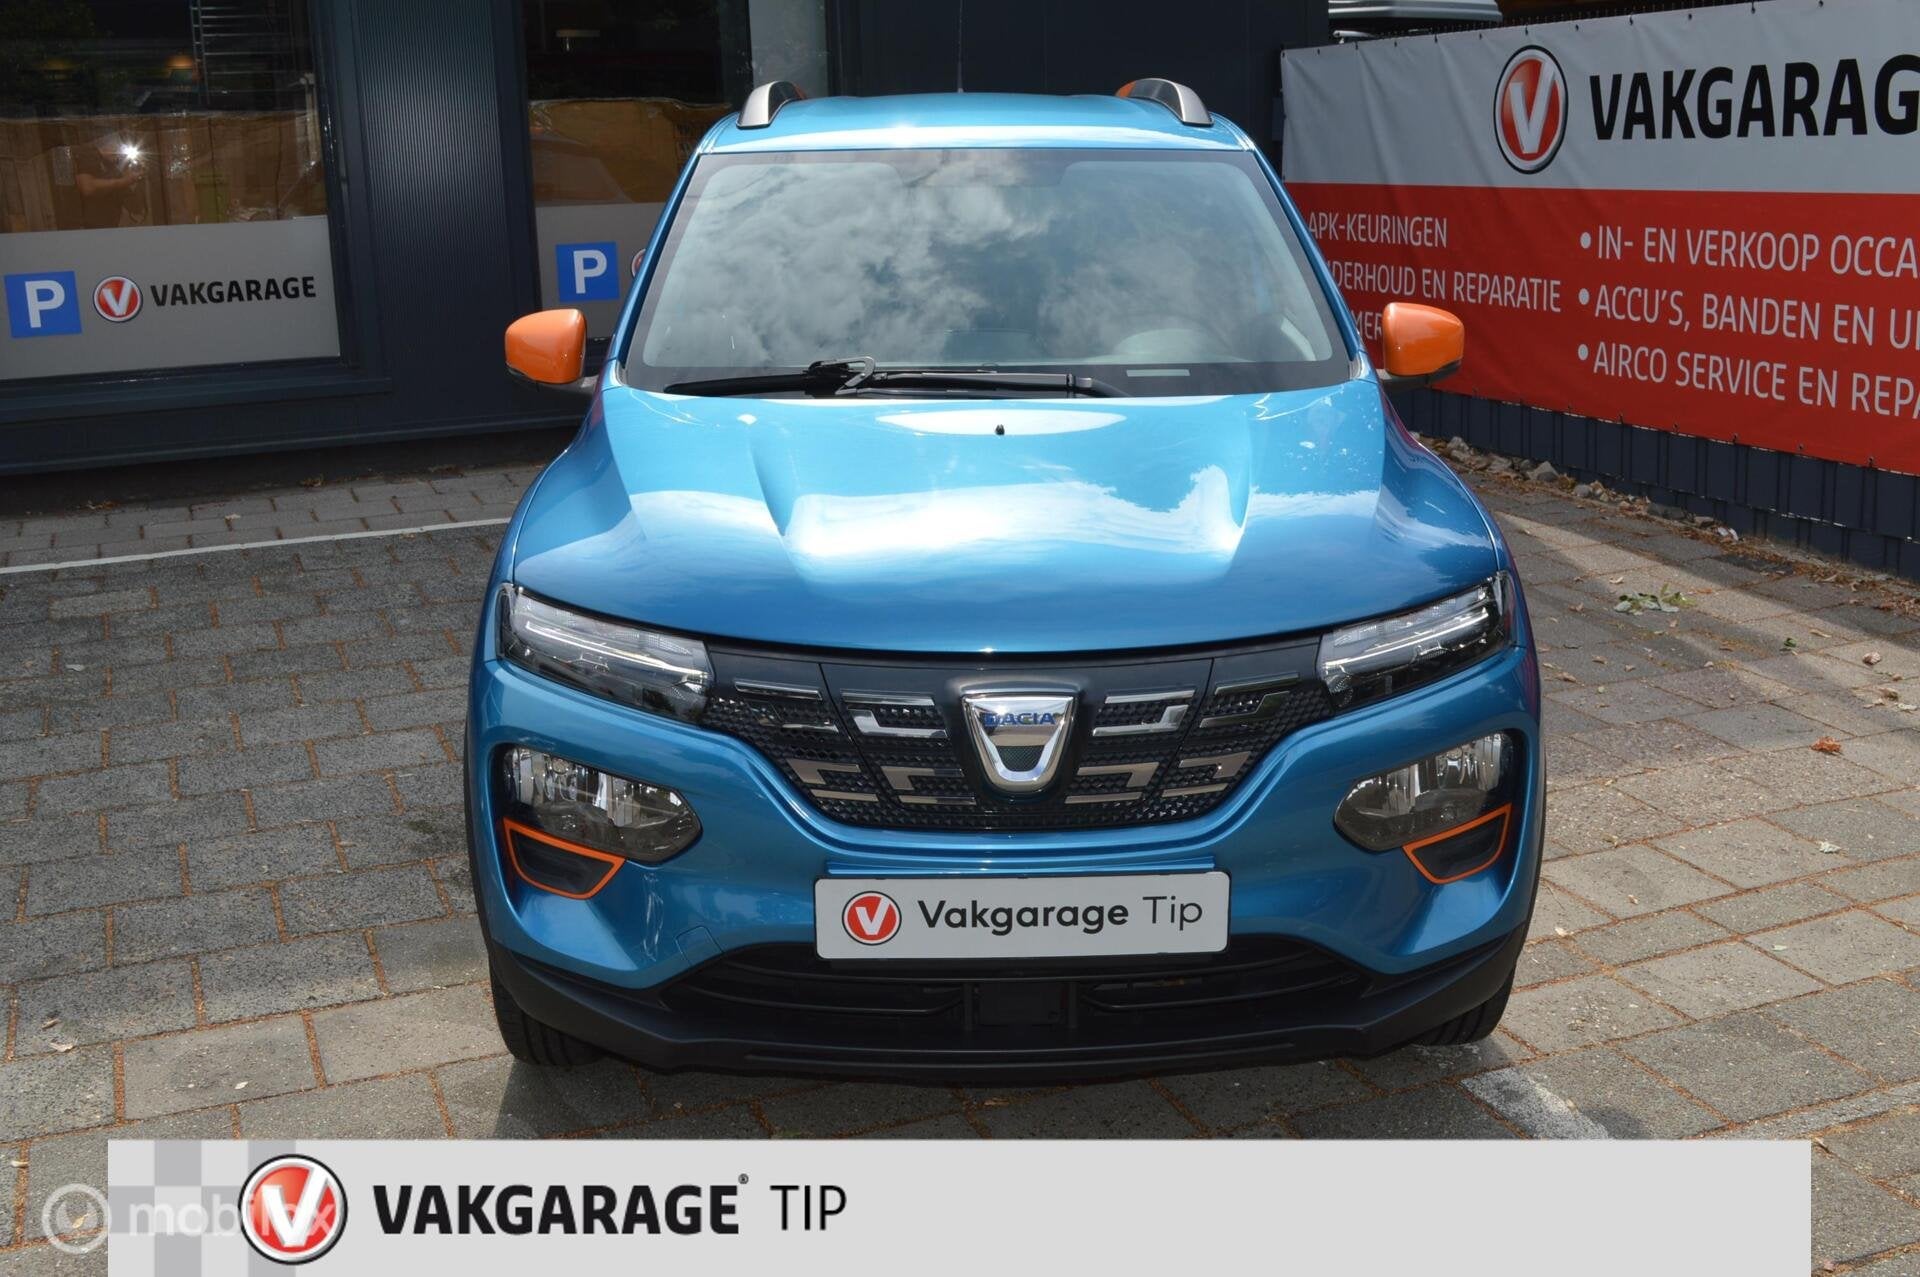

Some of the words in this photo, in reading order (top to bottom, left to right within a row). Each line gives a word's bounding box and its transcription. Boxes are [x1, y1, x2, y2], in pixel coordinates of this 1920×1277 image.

[1589, 53, 1920, 141] VAKGARAG
[1309, 212, 1447, 248] APK-KEURINGEN
[1598, 225, 1634, 260] IN-
[1644, 227, 1677, 264] EN
[1686, 228, 1820, 272] VERKOOP
[1830, 234, 1920, 279] OCCA
[150, 276, 316, 307] VAKGARAGE
[573, 249, 607, 294] P
[1327, 260, 1416, 297] DERHOUD
[1422, 268, 1446, 300] EN
[1453, 271, 1561, 313] REPARATIE
[24, 280, 65, 328] P
[1595, 284, 1690, 332] ACCU'S,
[1702, 293, 1820, 340] BANDEN
[1833, 304, 1874, 346] EN
[1593, 341, 1667, 383] AIRCO
[1675, 351, 1787, 401] SERVICE
[1798, 366, 1837, 408] EN
[983, 712, 1056, 726] DACIA
[918, 900, 1129, 936] Vakgarage
[1142, 895, 1203, 931] Tip
